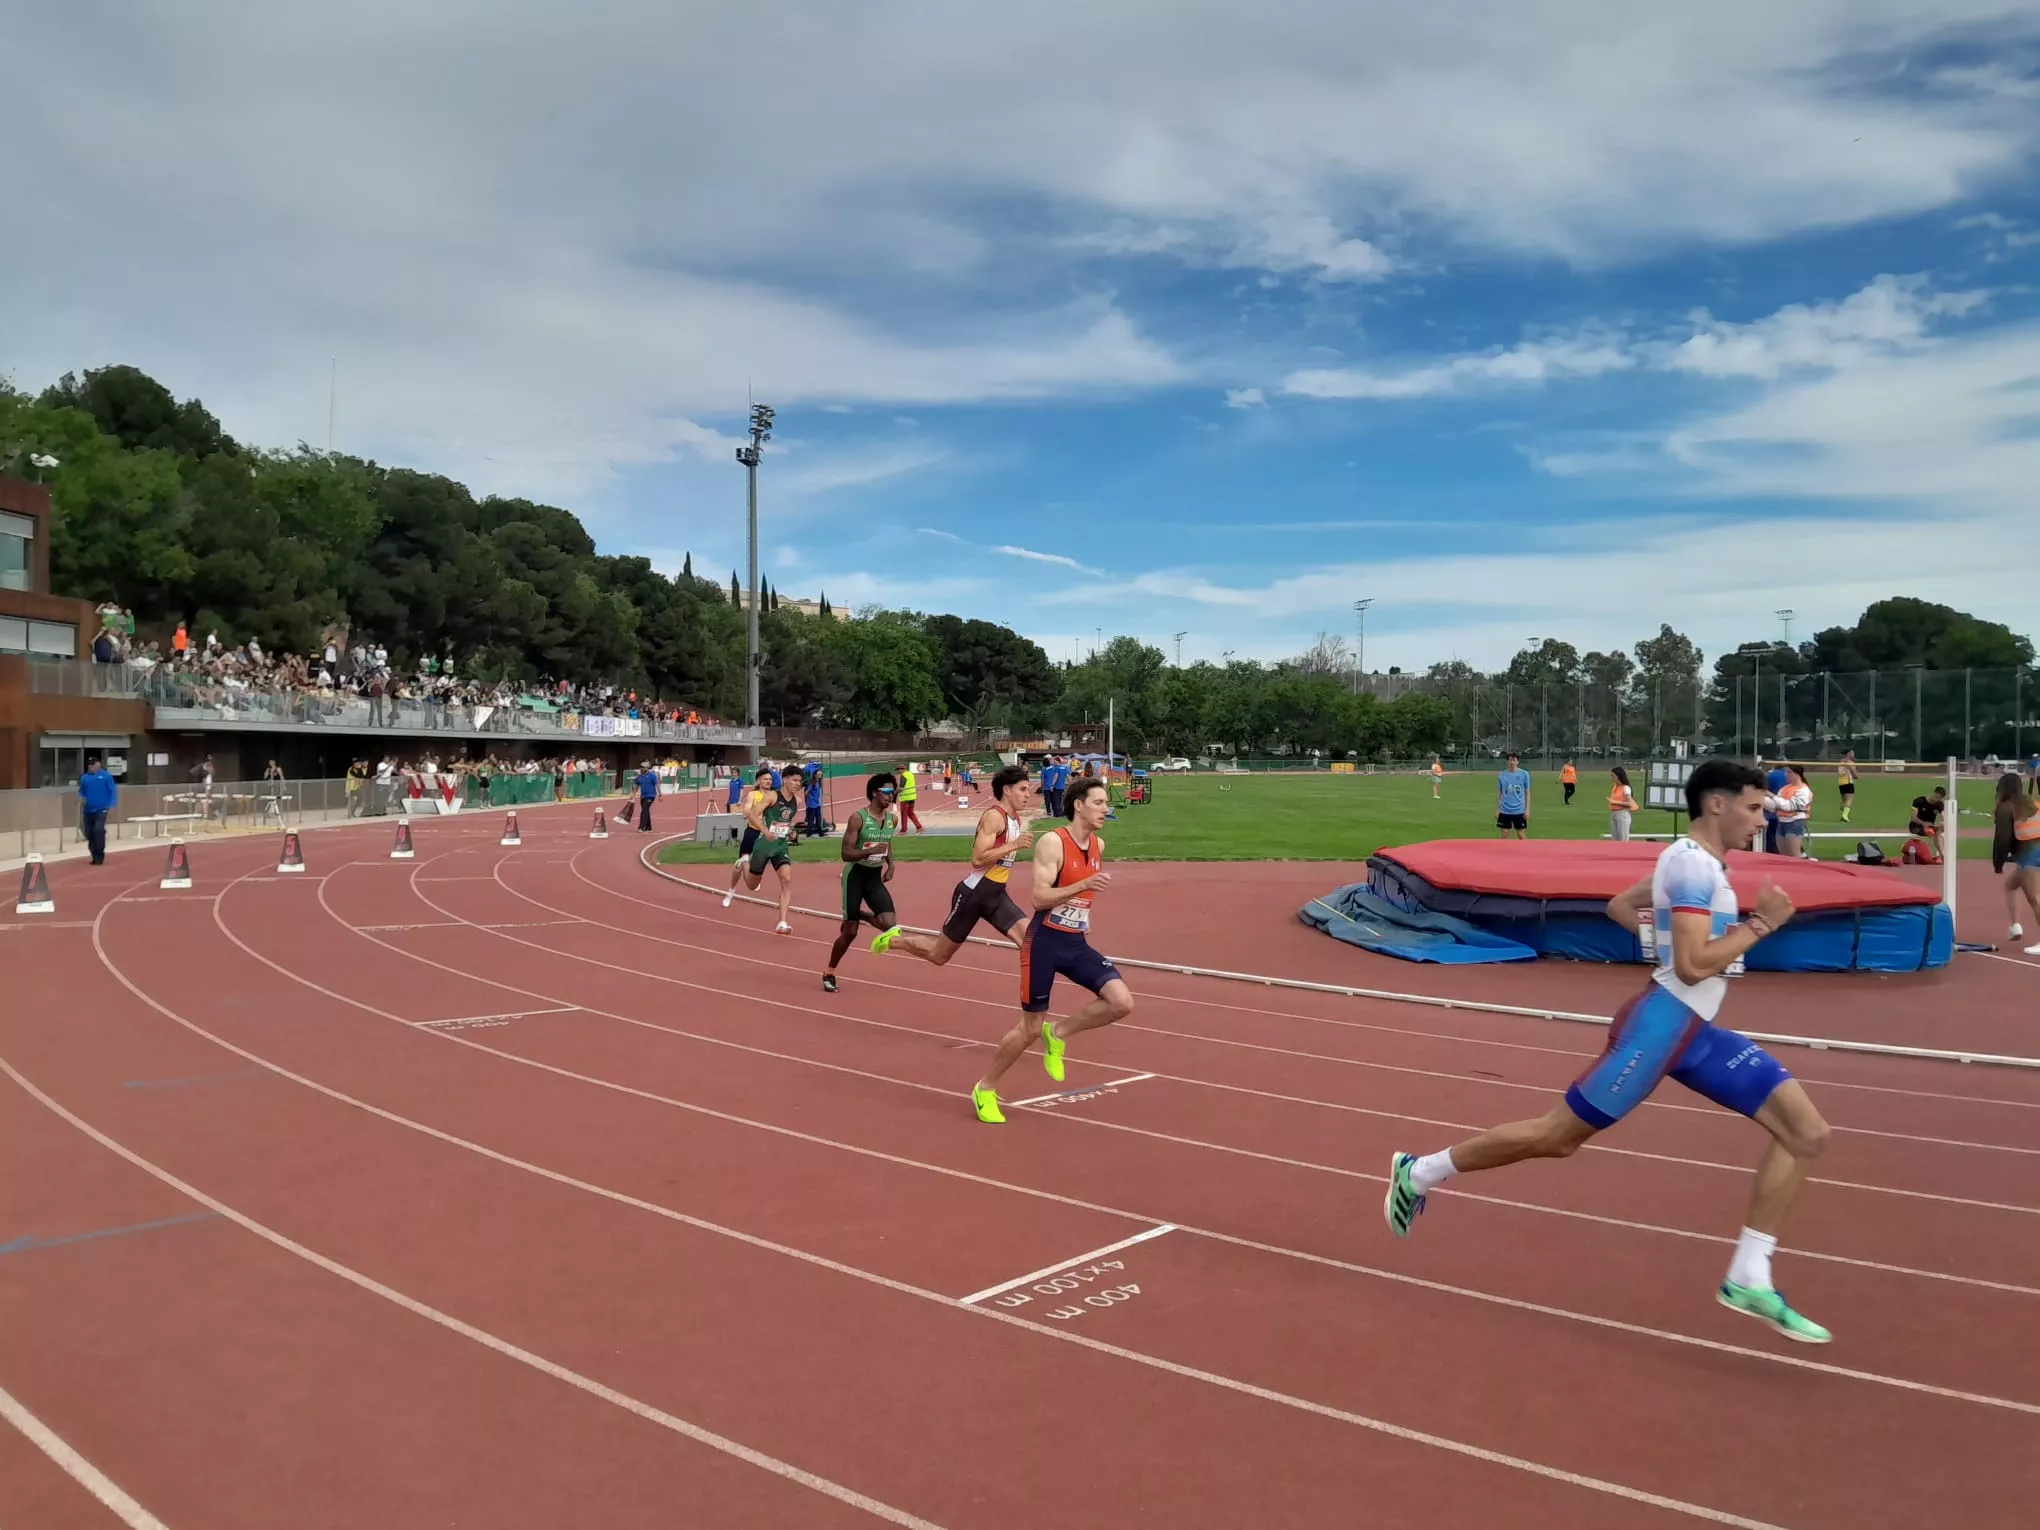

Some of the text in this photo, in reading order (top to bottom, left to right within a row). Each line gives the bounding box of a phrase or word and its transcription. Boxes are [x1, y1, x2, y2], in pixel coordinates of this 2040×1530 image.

[995, 1260, 1125, 1307] 4x100 m
[1046, 1283, 1141, 1319] 400 m
